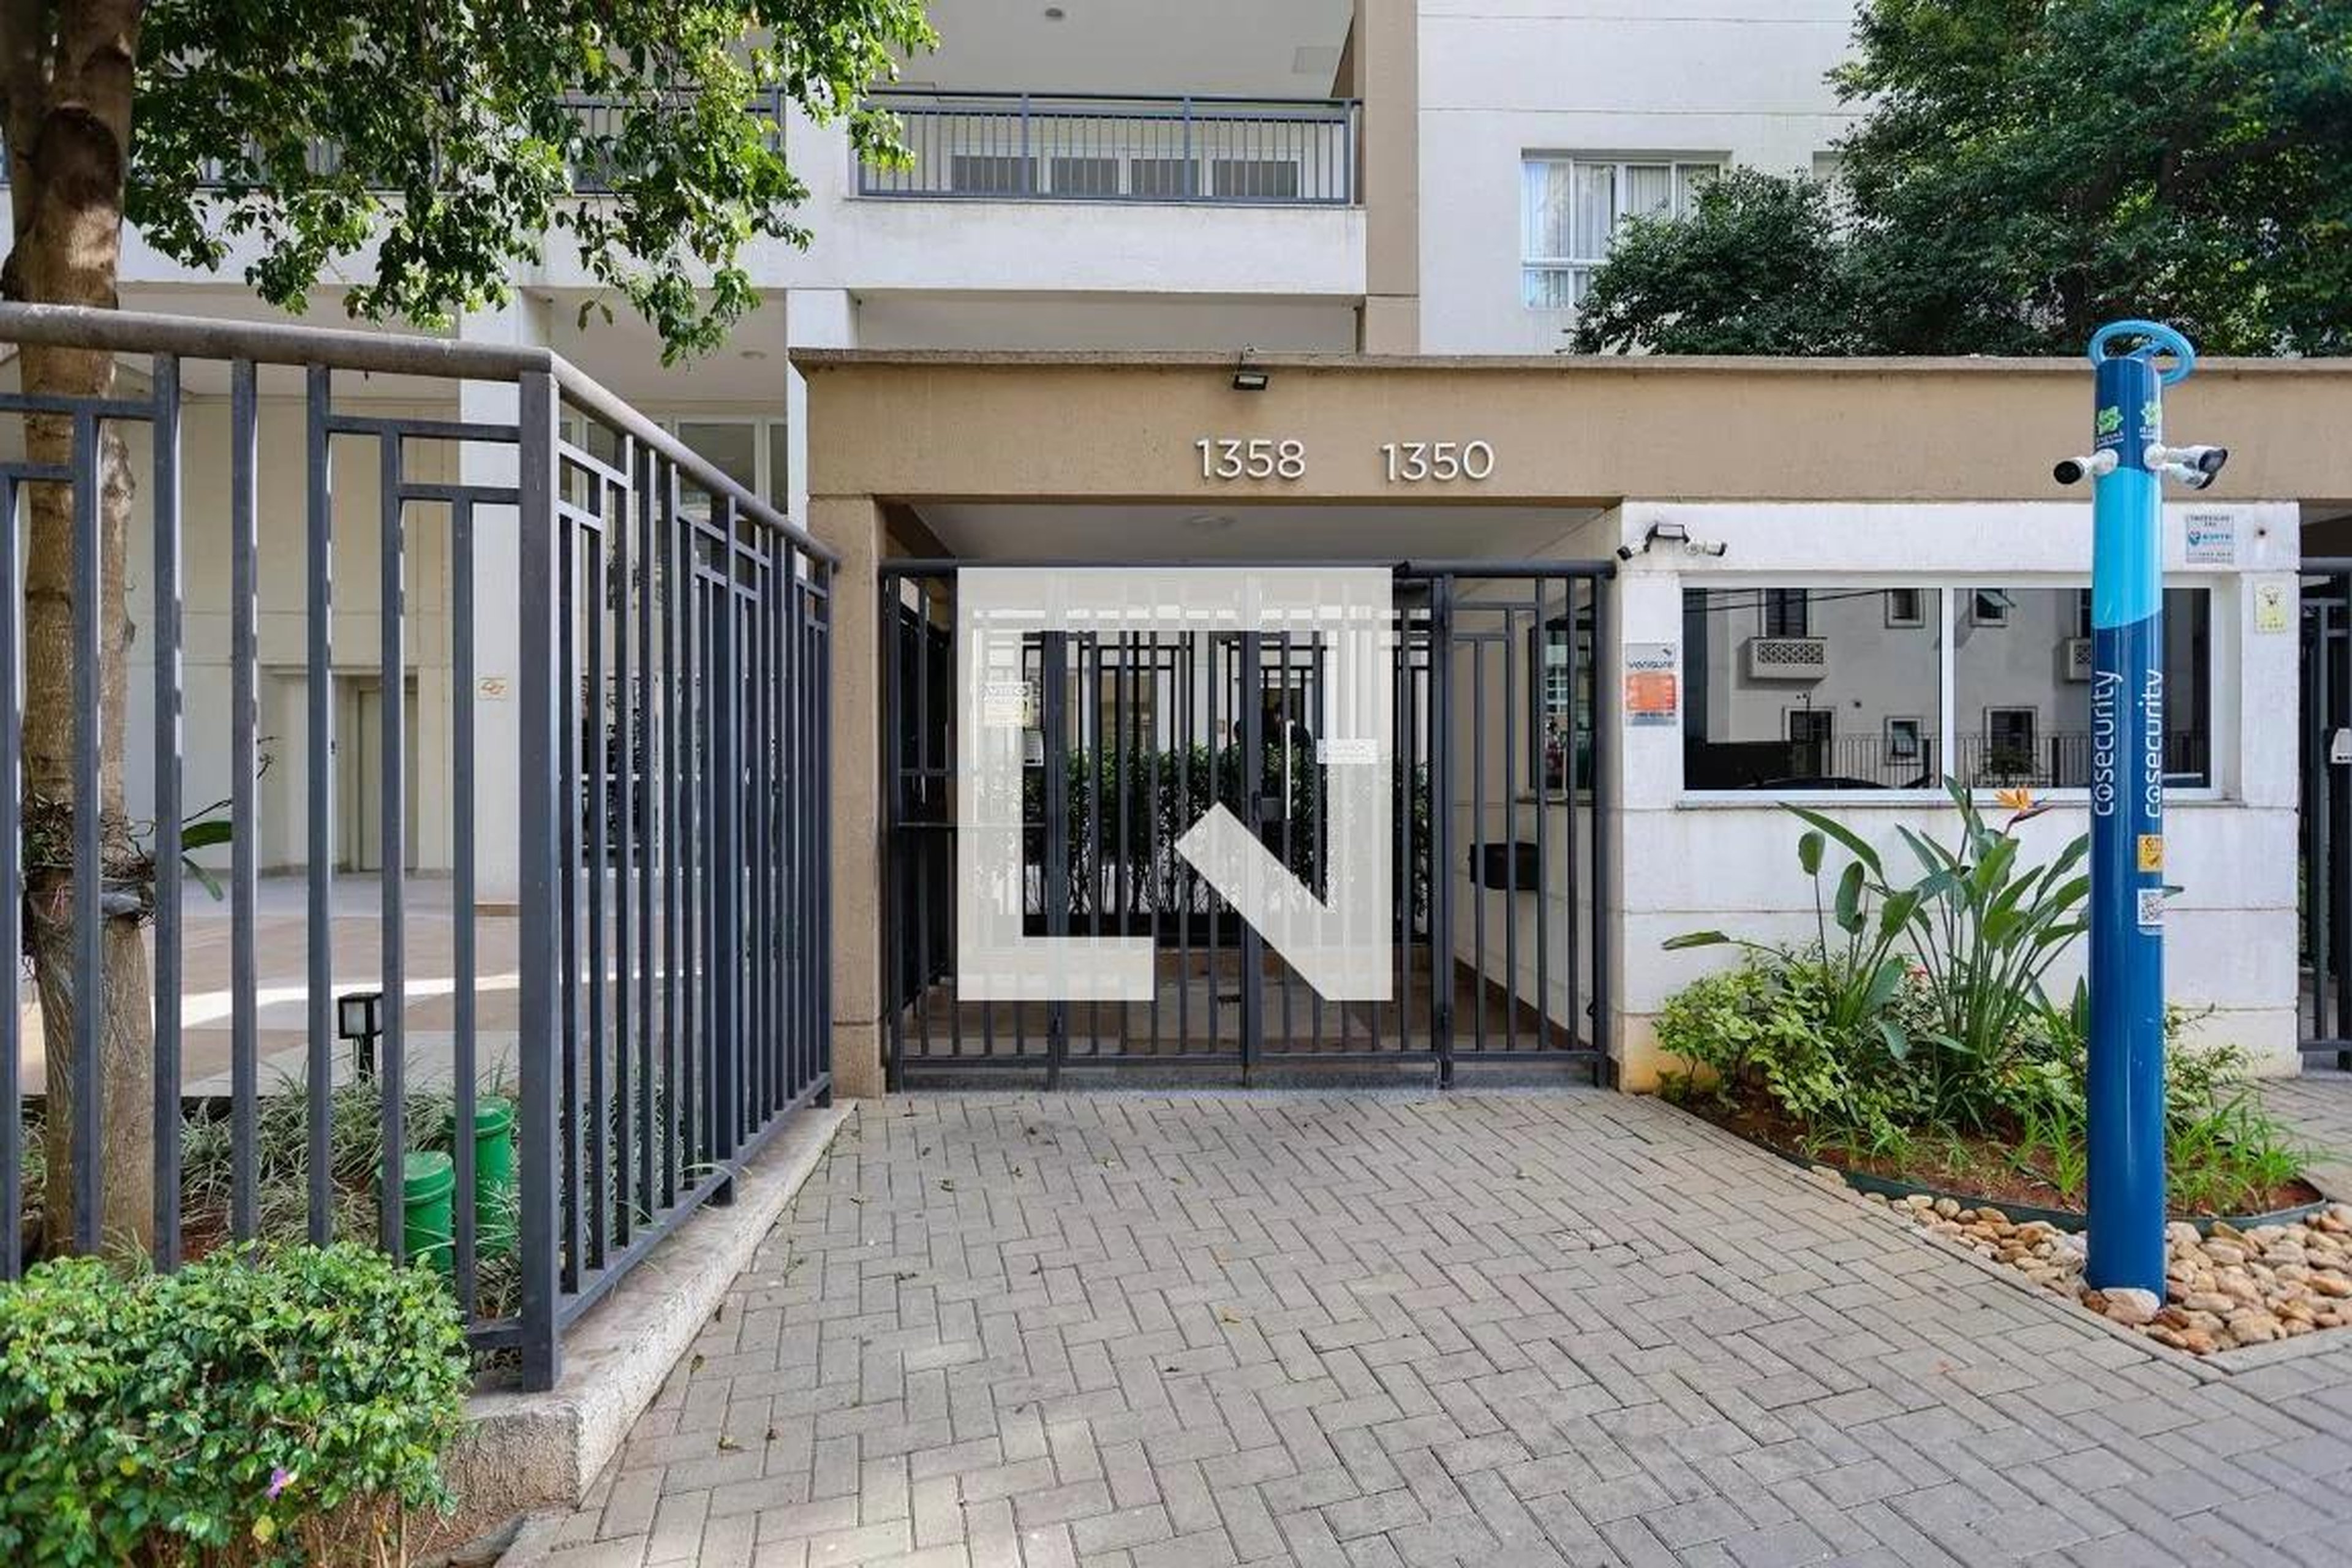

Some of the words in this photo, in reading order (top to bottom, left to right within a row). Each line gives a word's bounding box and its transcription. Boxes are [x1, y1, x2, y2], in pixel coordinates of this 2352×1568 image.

[1195, 439, 1306, 478] 1358
[1381, 440, 1495, 481] 1350
[2093, 671, 2124, 816] cosecurity
